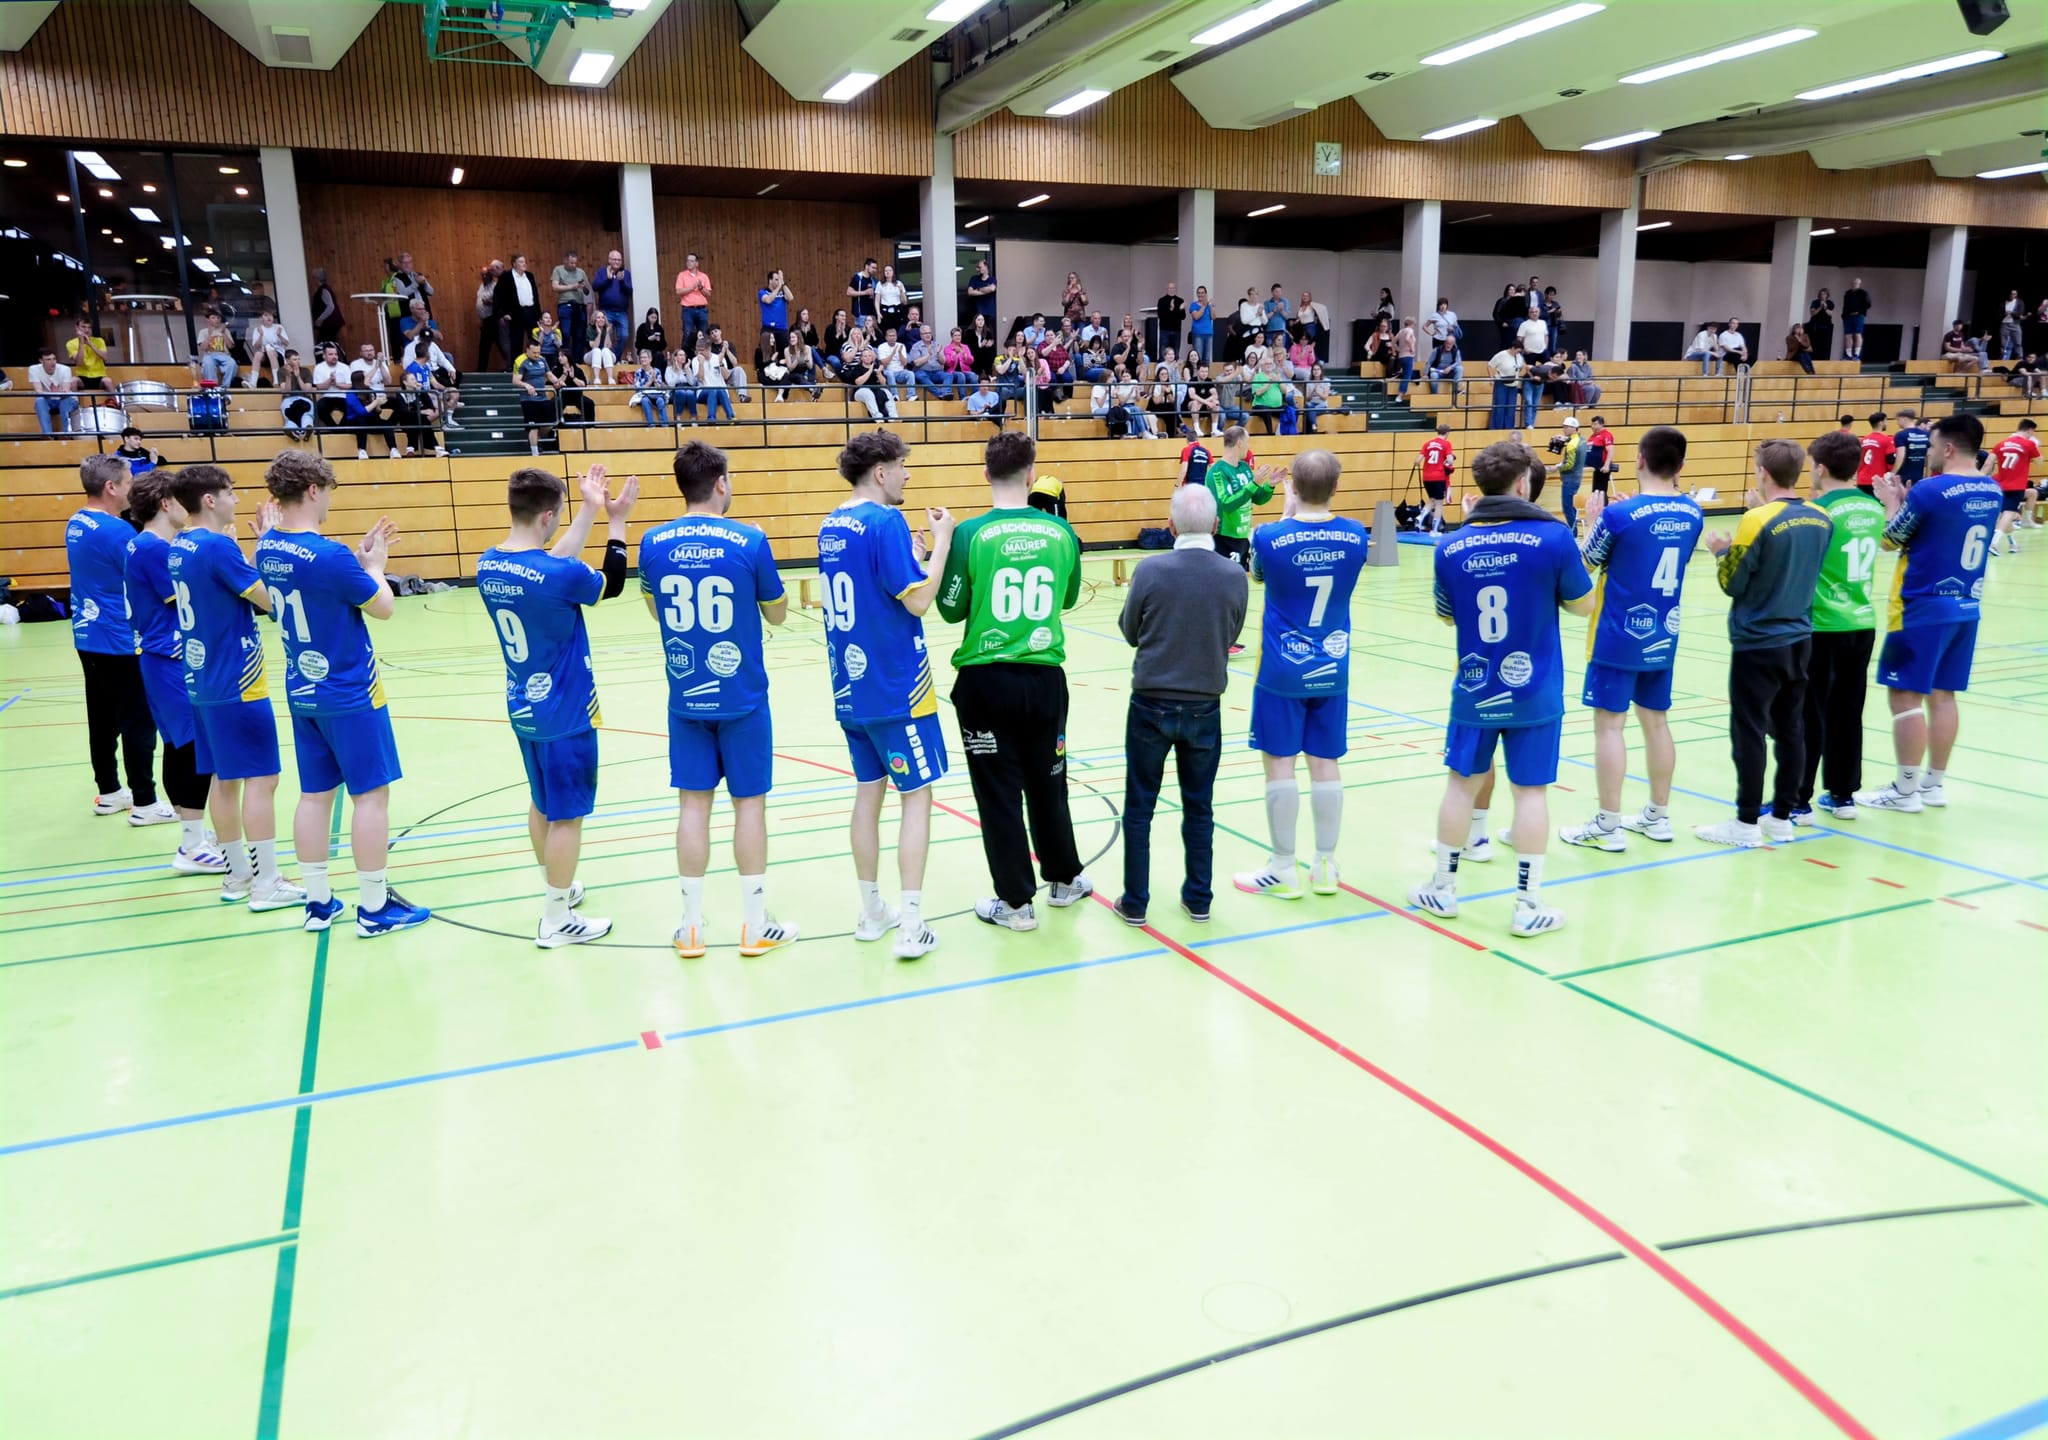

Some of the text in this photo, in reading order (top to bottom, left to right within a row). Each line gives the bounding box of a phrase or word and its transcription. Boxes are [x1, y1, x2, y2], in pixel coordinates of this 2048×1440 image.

[1427, 450, 1440, 465] 21
[2001, 452, 2019, 469] 77
[1630, 505, 1653, 521] HSG
[652, 524, 748, 547] HSG SCHÖNBUCH
[980, 521, 1062, 542] HSG SCHÖNBUCH
[1655, 521, 1691, 532] MAURER
[1005, 539, 1048, 553] MAURER
[1271, 529, 1361, 550] HSG SCHÖNBUCH
[1443, 532, 1542, 557] HSG SCHÖNBUCH
[1960, 524, 1988, 571] 6
[263, 538, 317, 563] SCHÖNBUCH
[674, 548, 725, 560] MAURER
[1298, 550, 1346, 563] MAURER
[1468, 553, 1518, 569] MAURER
[1841, 536, 1877, 582] 12
[263, 562, 294, 574] MAURER
[482, 559, 546, 585] SCHÖNBUCH
[1651, 547, 1680, 597] 4
[483, 583, 525, 596] MAURER
[991, 566, 1055, 623] 66
[659, 574, 735, 633] 36
[1305, 575, 1334, 628] 7
[267, 585, 312, 643] 21
[1476, 585, 1508, 643] 8
[1631, 617, 1653, 628] HdB
[496, 608, 529, 663] 9
[668, 653, 690, 665] HdB
